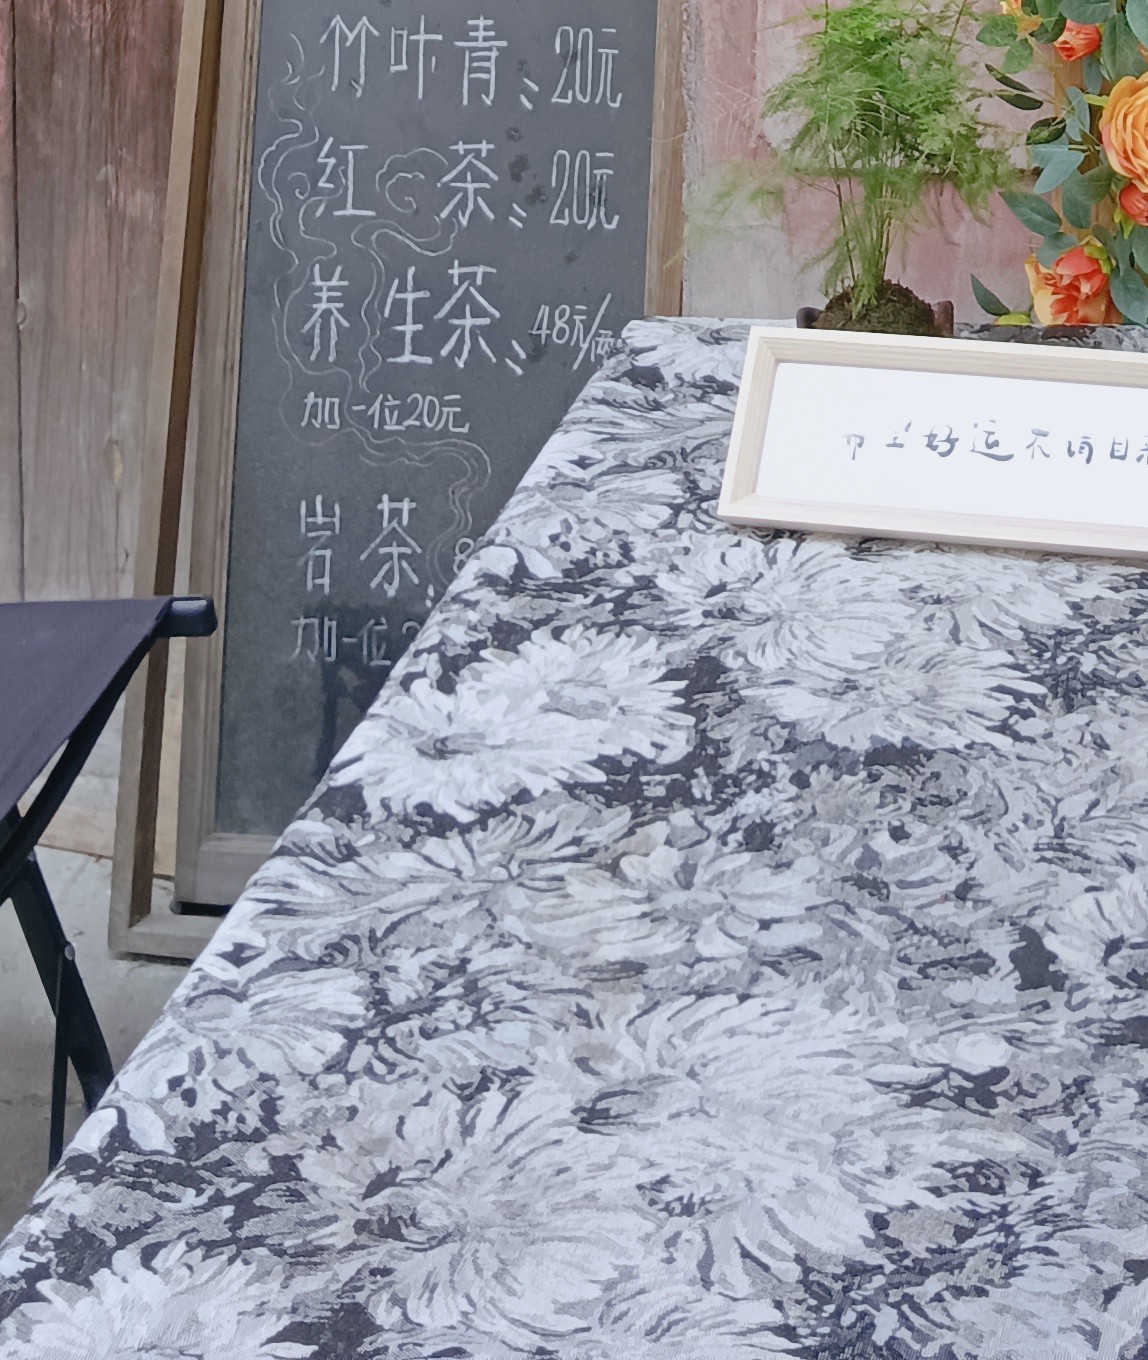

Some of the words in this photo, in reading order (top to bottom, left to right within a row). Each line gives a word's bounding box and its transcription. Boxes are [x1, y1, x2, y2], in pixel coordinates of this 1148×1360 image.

[550, 25, 623, 109] 20元
[549, 149, 620, 230] 20元
[301, 392, 470, 433] 加一位20元
